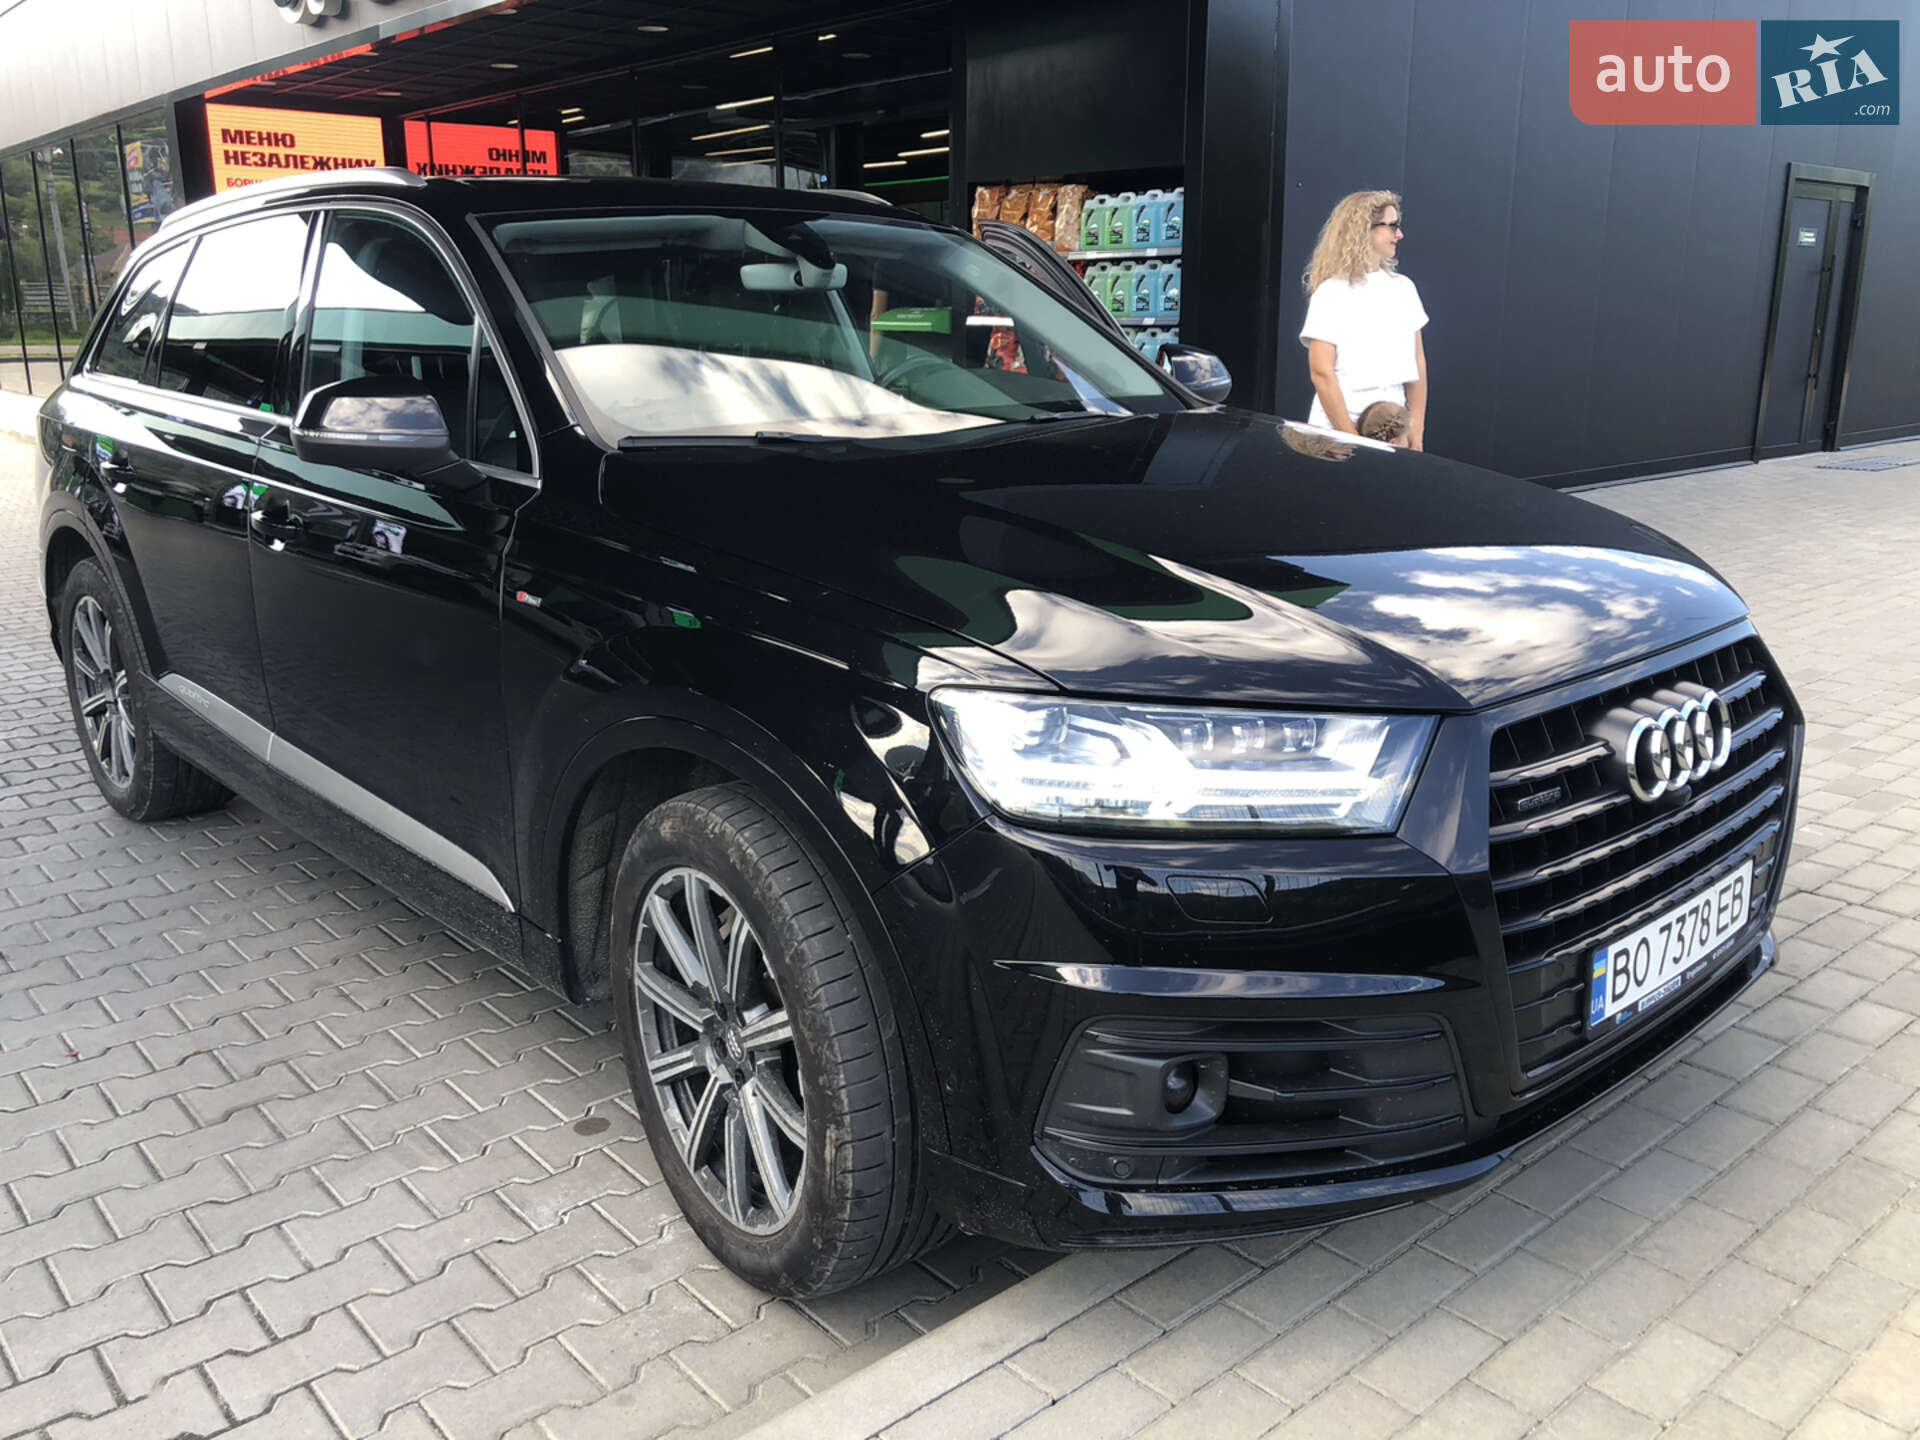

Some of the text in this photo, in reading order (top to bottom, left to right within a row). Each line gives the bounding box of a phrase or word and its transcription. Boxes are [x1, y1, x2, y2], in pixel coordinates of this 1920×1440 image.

[221, 128, 296, 149] МЕНЮ
[1611, 937, 1650, 1004] BO
[1658, 898, 1712, 976] 7378
[1716, 875, 1745, 936] EB
[1591, 996, 1604, 1014] UA
